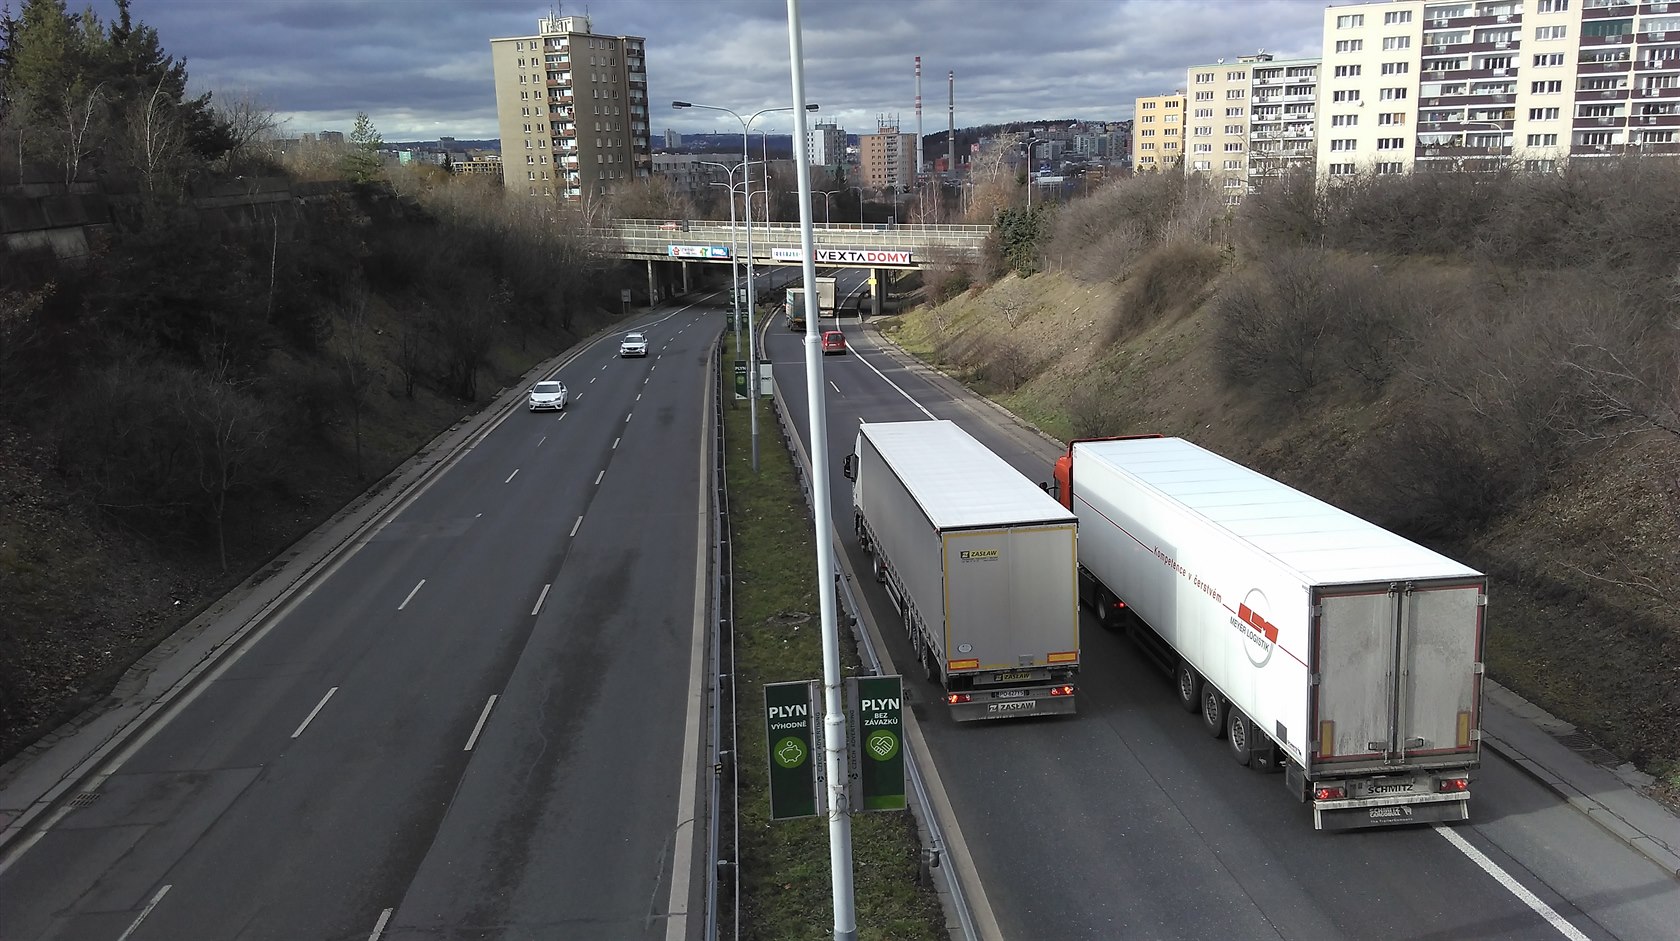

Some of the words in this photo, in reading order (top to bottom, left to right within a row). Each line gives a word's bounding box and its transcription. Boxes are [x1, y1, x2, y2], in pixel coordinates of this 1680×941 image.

[1153, 545, 1186, 577] Kompetence
[1230, 616, 1247, 635] MEYER
[1246, 629, 1270, 652] LOGISTIK
[769, 704, 808, 719] PLYN
[861, 698, 900, 711] PLYN
[771, 720, 807, 730] VÝHODNĚ
[1368, 784, 1413, 794] SCHMITZ
